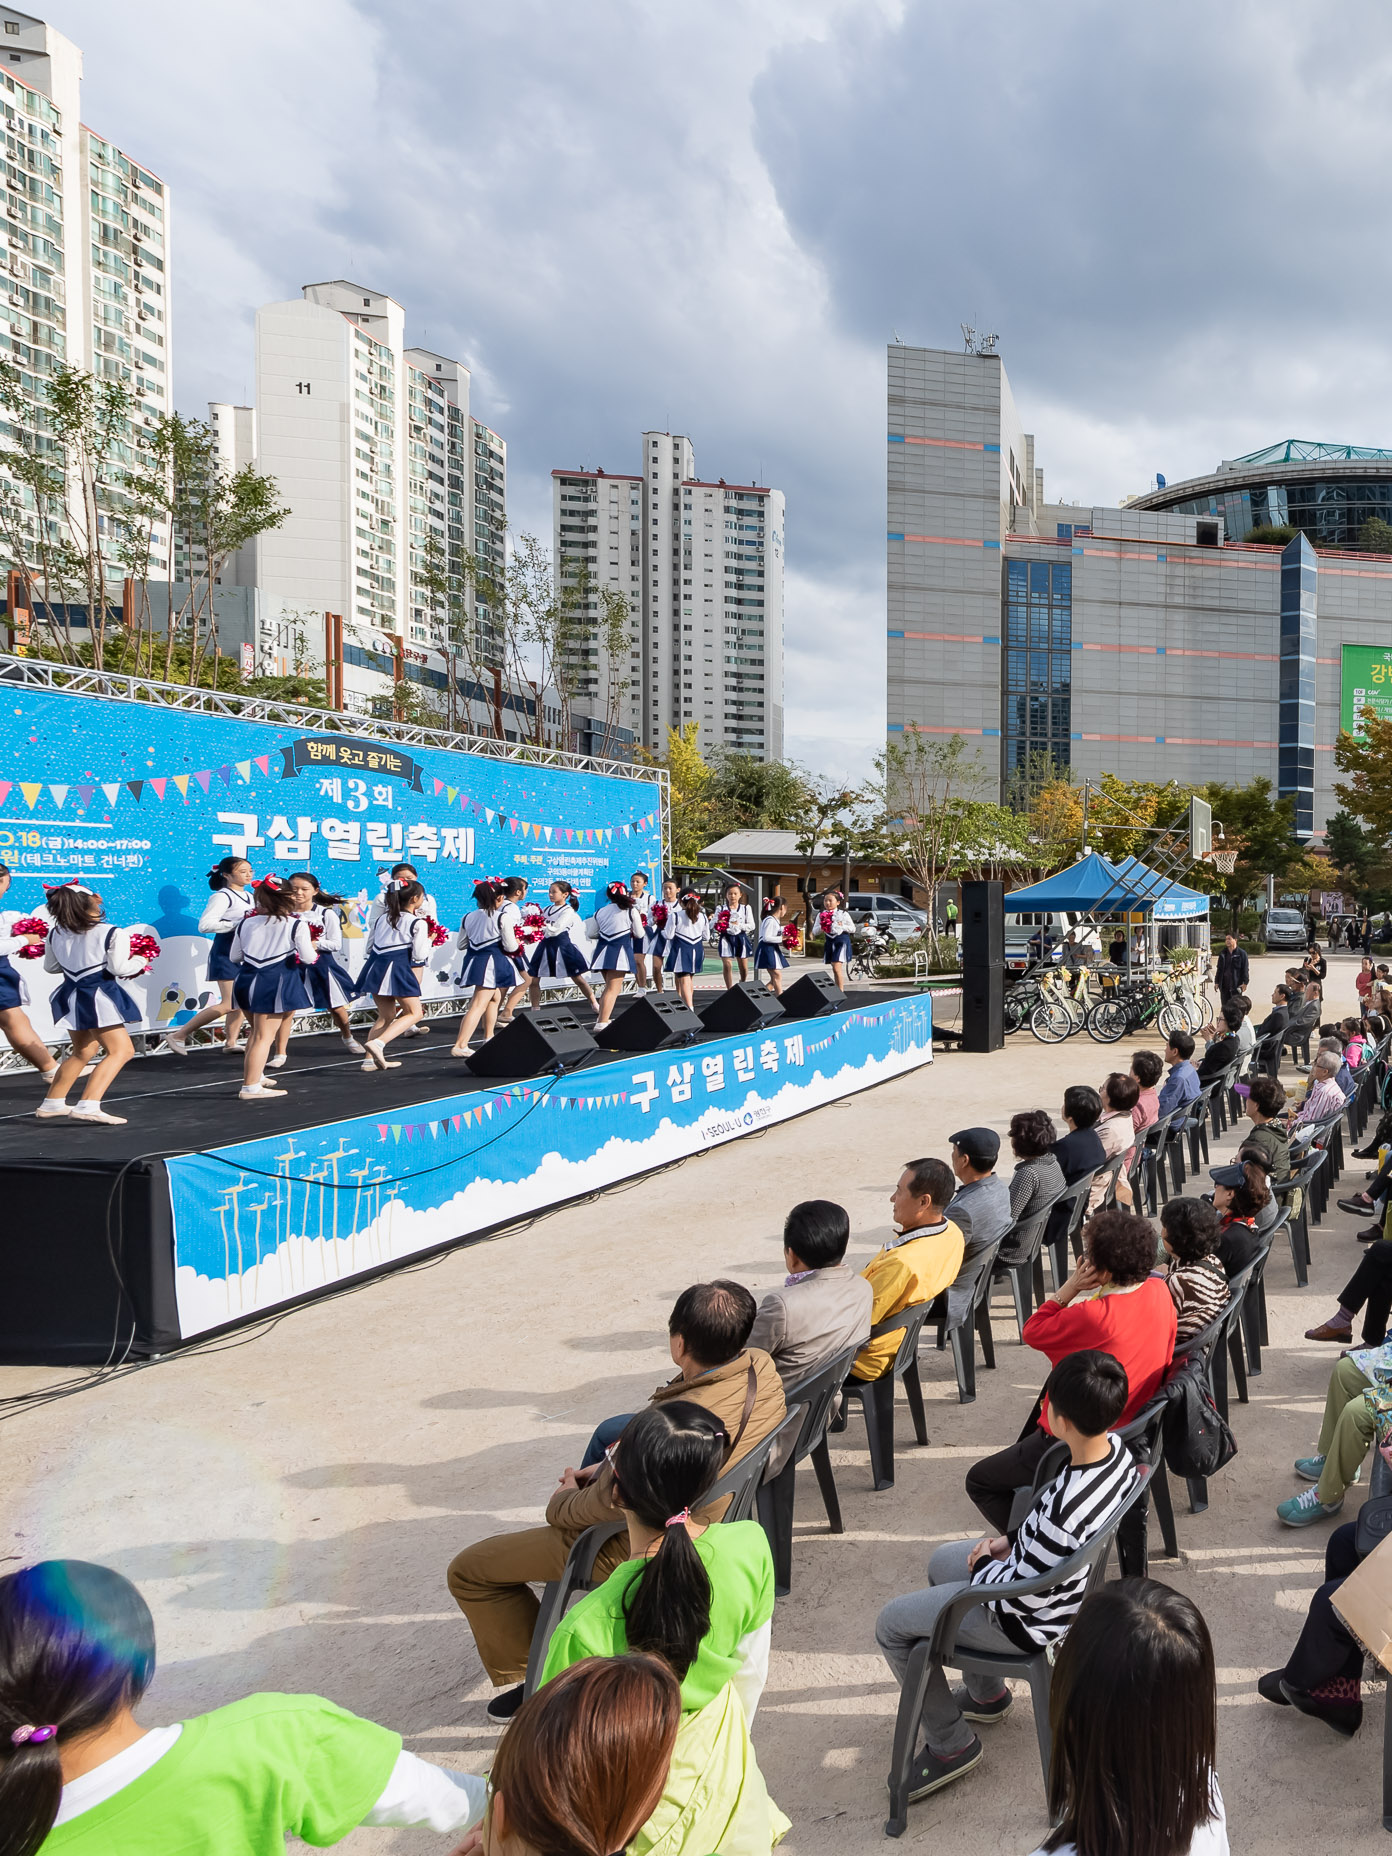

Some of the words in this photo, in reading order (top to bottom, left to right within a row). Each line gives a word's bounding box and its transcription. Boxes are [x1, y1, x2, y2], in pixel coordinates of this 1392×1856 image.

[295, 381, 311, 395] 11
[306, 741, 336, 760] 함께
[338, 746, 365, 765] 웃고
[366, 751, 402, 771] 즐기는
[319, 777, 393, 812] 제3회
[212, 812, 475, 865] 구삼열린축제
[100, 853, 143, 868] 건너편)
[629, 1033, 805, 1114] 구삼열린축제
